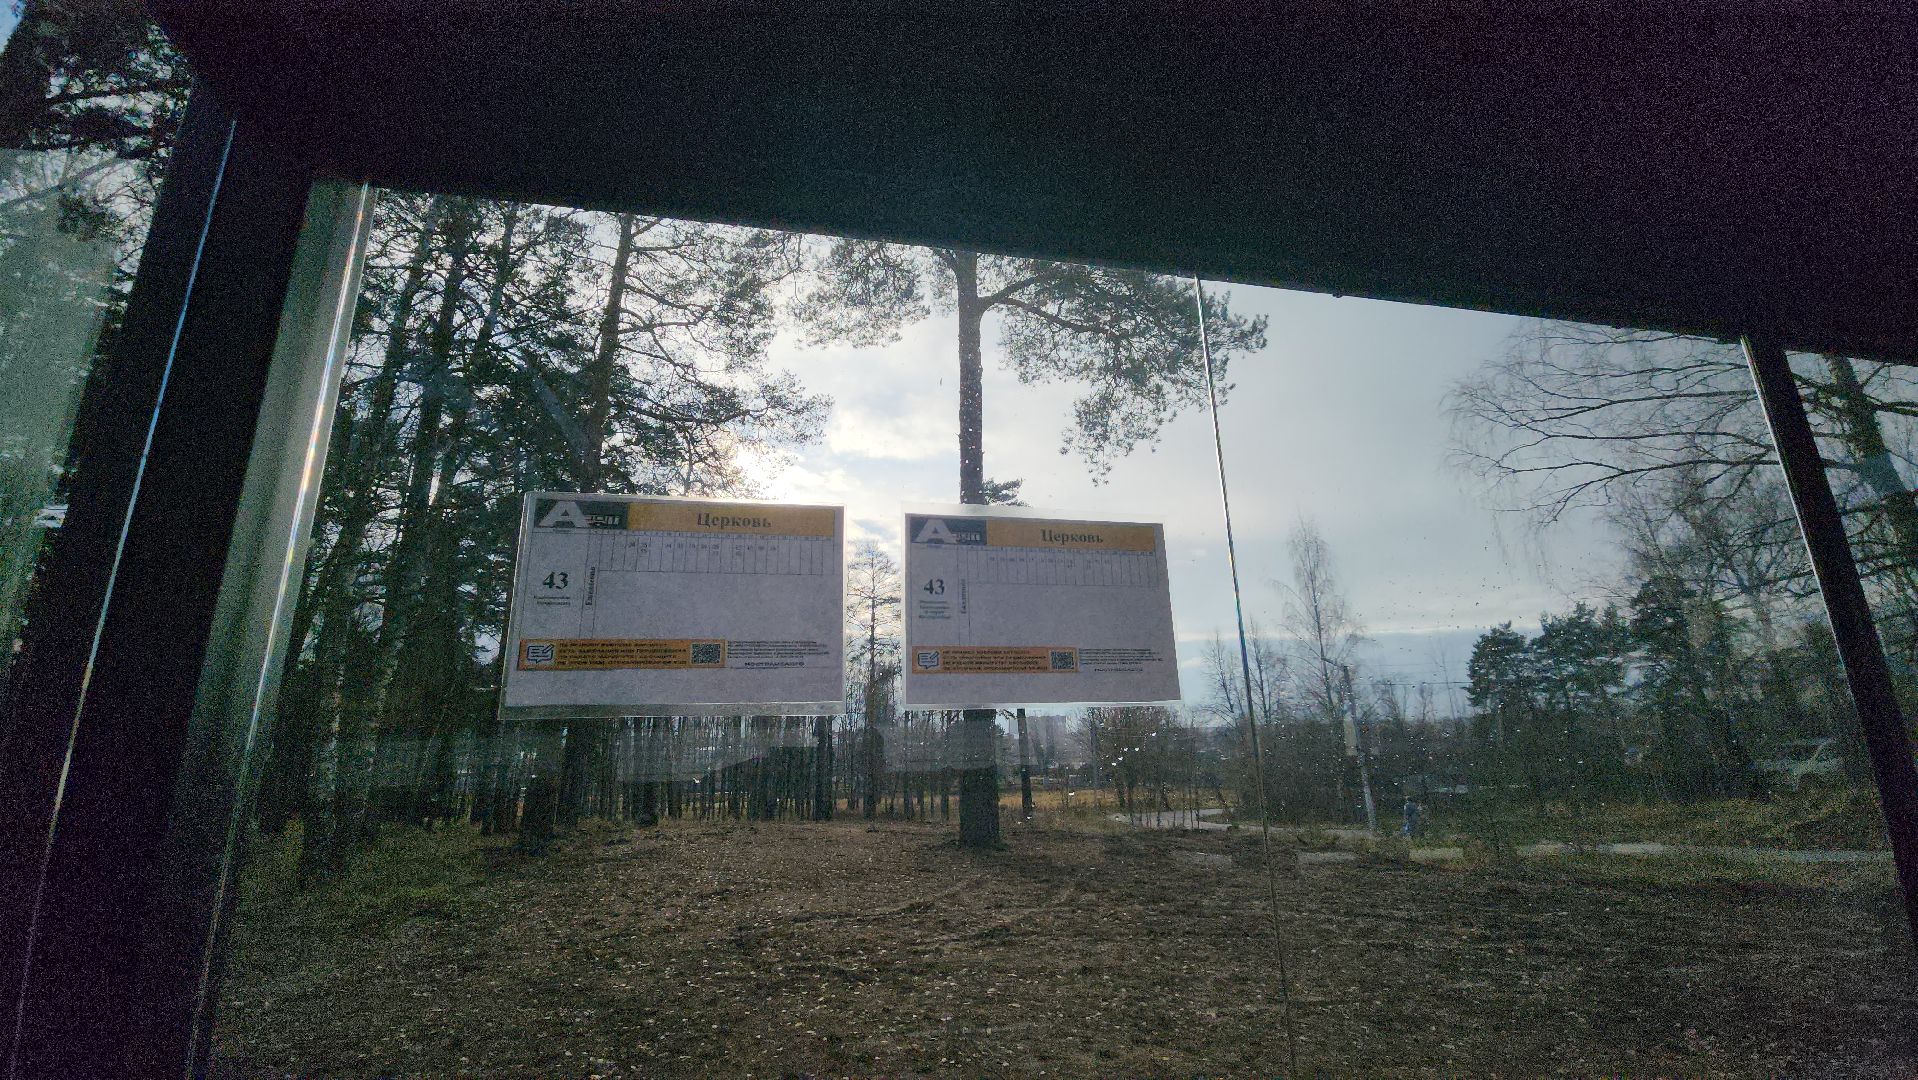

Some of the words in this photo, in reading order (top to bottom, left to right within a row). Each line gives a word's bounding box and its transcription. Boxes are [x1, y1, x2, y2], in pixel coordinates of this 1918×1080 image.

[697, 511, 772, 530] Церковь
[1040, 528, 1104, 546] Церковь
[542, 571, 569, 590] 43
[923, 578, 945, 596] 43
